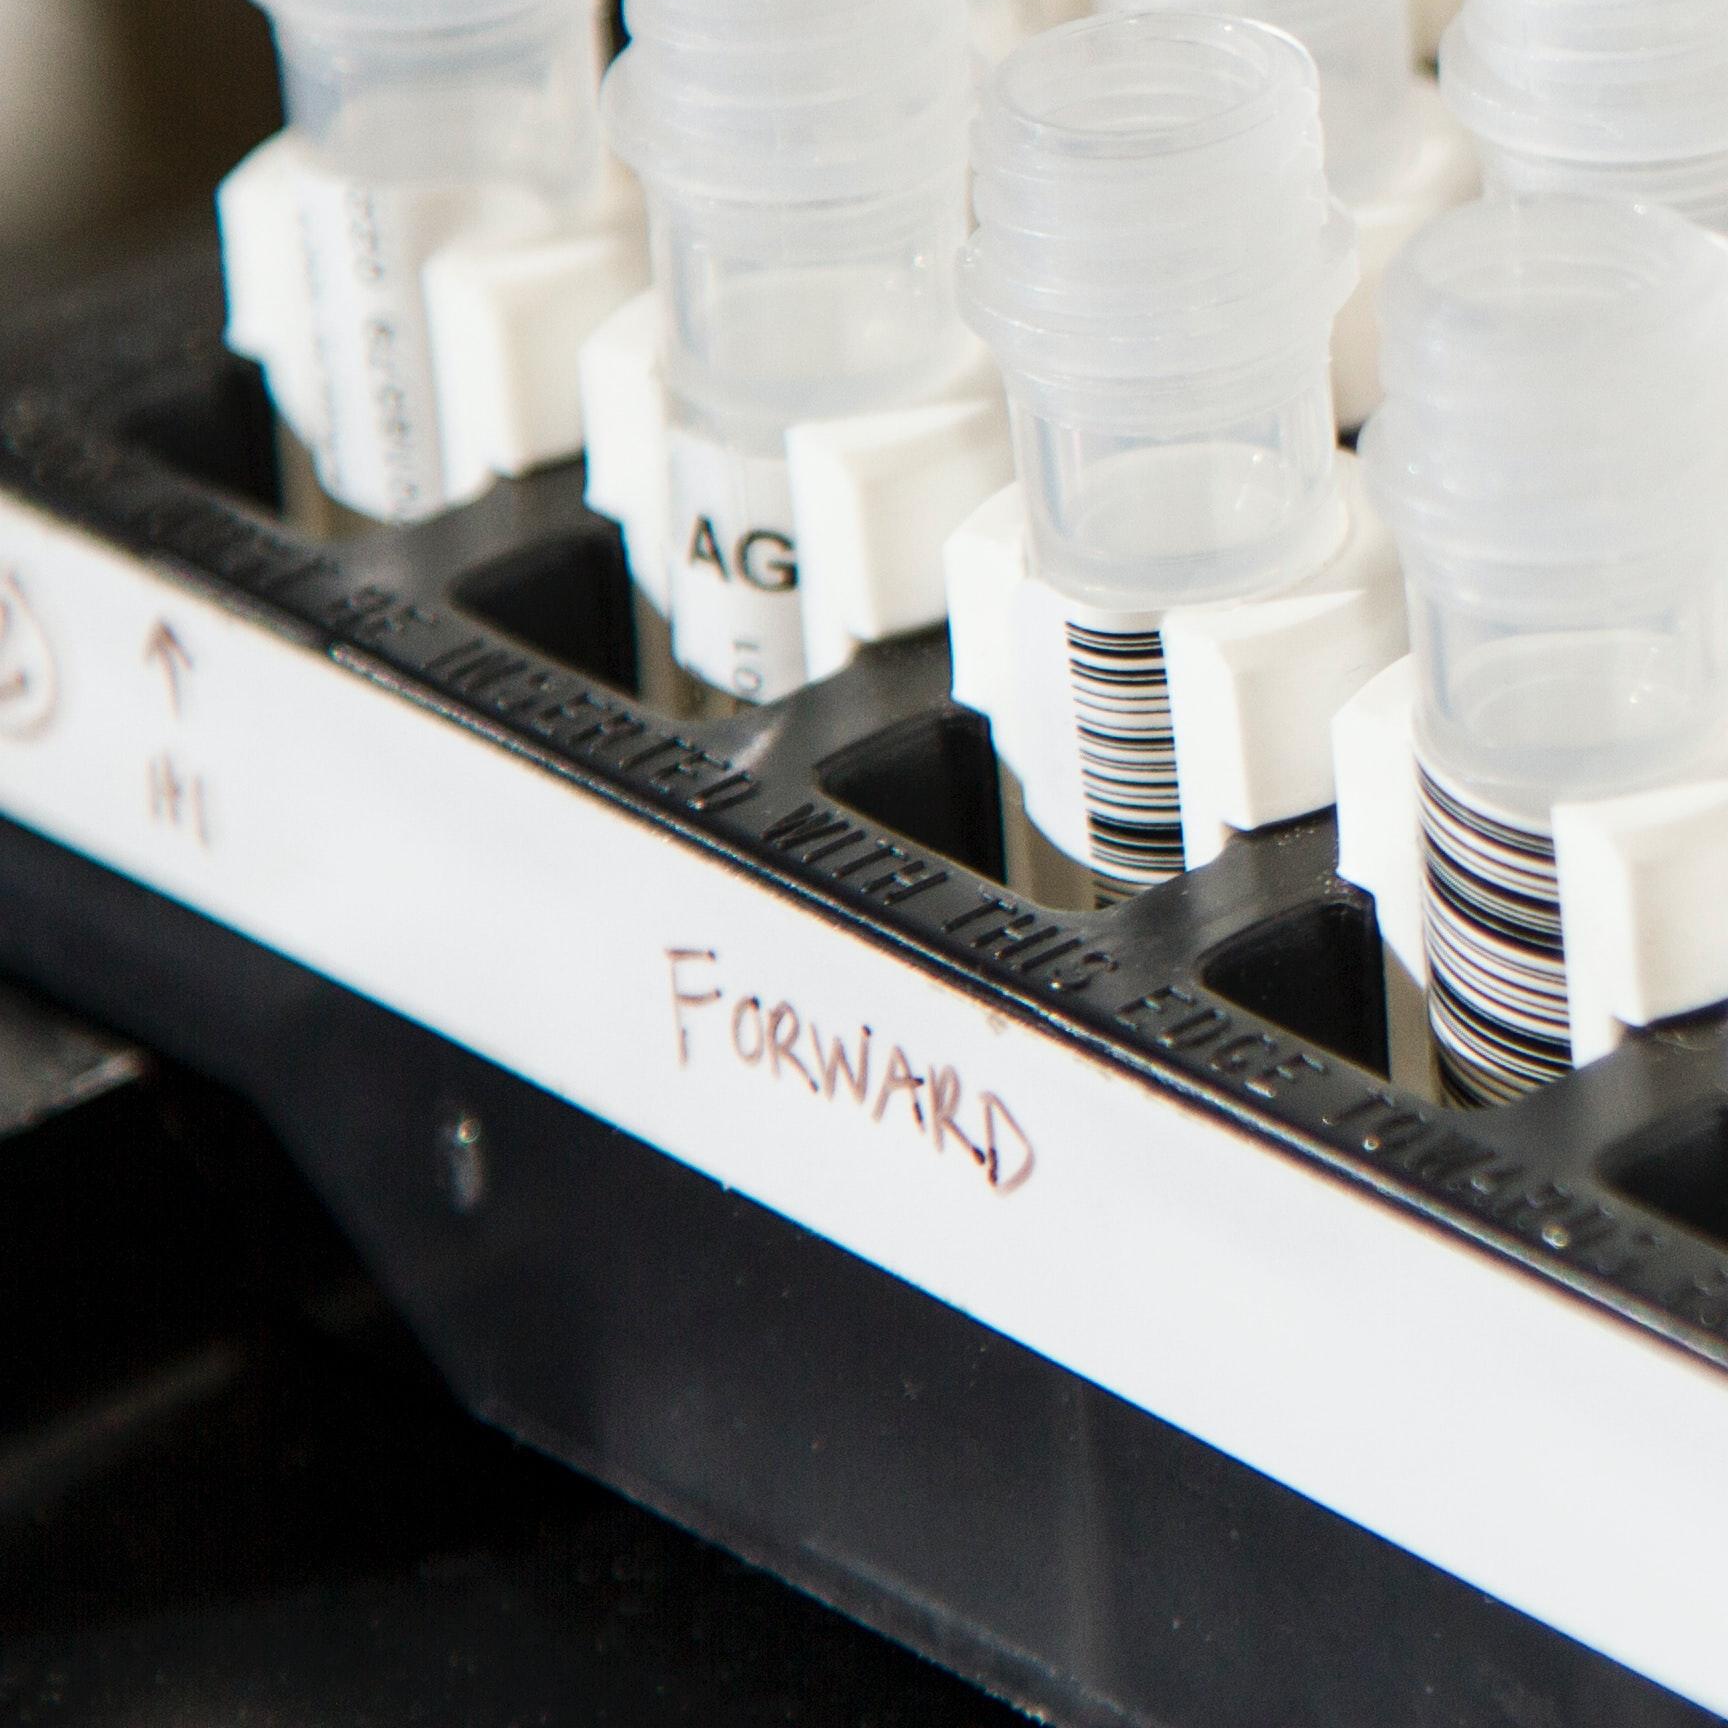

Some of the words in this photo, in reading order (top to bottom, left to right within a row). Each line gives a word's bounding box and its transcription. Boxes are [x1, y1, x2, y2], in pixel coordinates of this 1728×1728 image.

[687, 514, 800, 593] AG
[421, 636, 757, 814] INSERTED
[760, 800, 950, 905] WITH
[943, 883, 1119, 993] THIS
[1116, 983, 1329, 1100] EDGE
[665, 947, 1035, 1197] FORWARD
